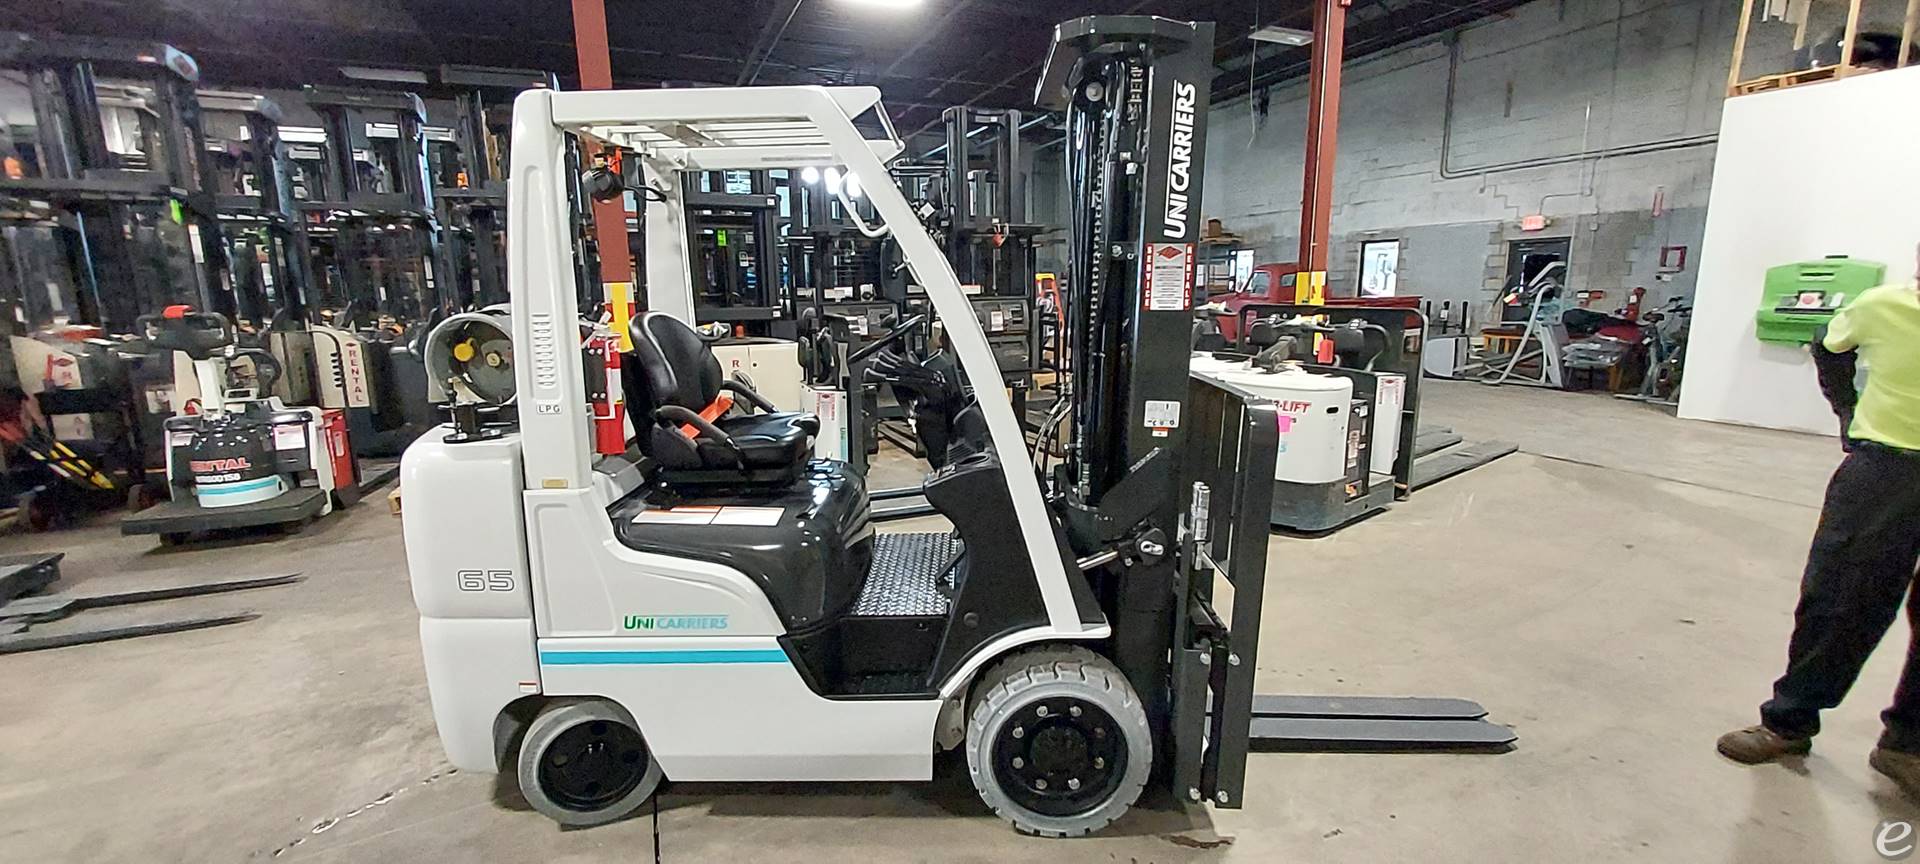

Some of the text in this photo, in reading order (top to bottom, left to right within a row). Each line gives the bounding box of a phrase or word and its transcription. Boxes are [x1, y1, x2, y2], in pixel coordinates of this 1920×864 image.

[1144, 245, 1153, 307] SERVICE
[1184, 245, 1193, 307] RENTALS
[349, 350, 362, 402] RENTAL
[457, 569, 515, 592] 65
